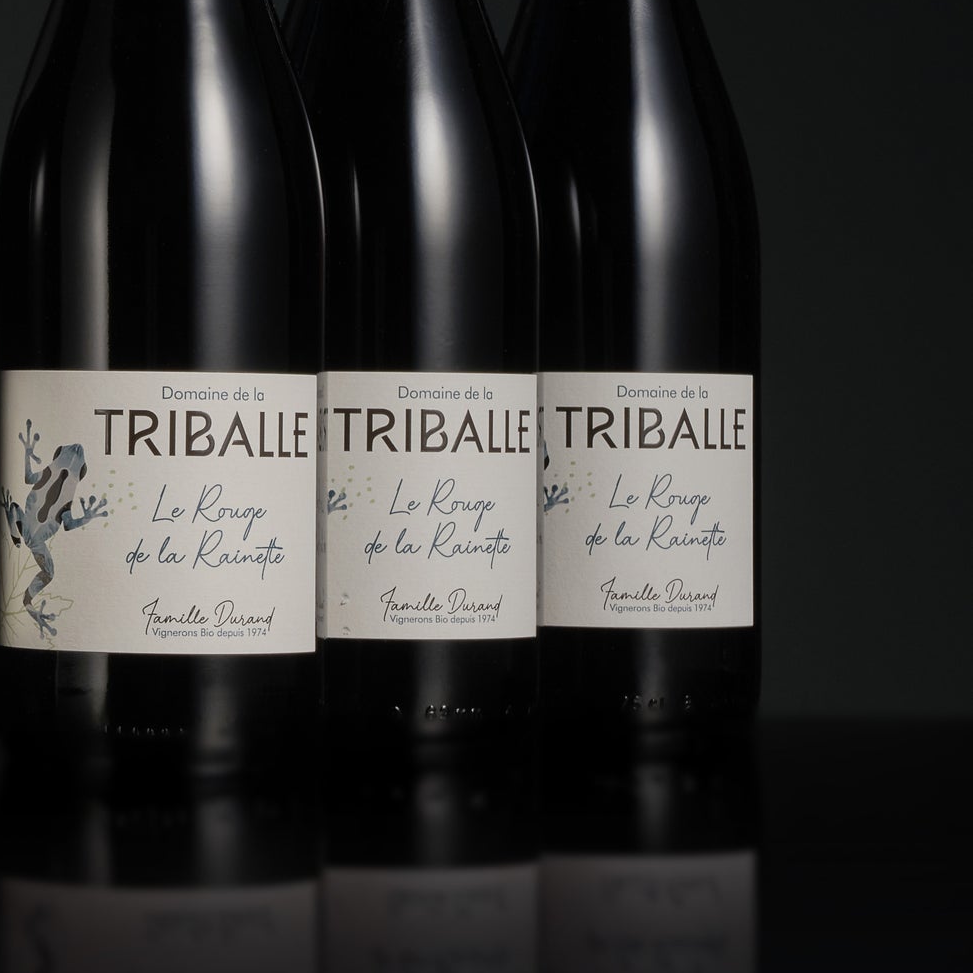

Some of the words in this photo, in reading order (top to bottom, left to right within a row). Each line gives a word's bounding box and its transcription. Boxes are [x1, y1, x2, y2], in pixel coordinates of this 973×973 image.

[162, 386, 229, 401] Domaine
[233, 387, 250, 401] de
[253, 387, 265, 401] la
[398, 386, 460, 400] Domaine
[465, 386, 481, 401] de
[483, 387, 493, 401] la
[617, 385, 677, 399] Domaine
[680, 385, 696, 399] de
[698, 385, 708, 399] la
[94, 409, 308, 458] TRIBALLE
[333, 408, 530, 453] TRIBALLE
[556, 406, 746, 450] TRIBALLE
[152, 484, 185, 523] Le
[192, 484, 267, 541] Rouge
[389, 478, 421, 516] Le
[427, 479, 496, 532] Rouge
[609, 473, 639, 509] Le
[645, 473, 711, 524] Rouge
[126, 538, 150, 574] de
[158, 536, 186, 563] la
[193, 529, 285, 580] Rainette
[364, 530, 387, 565] de
[394, 528, 422, 554] la
[428, 522, 511, 569] Rainette
[585, 522, 607, 557] de
[614, 522, 640, 546] la
[646, 515, 727, 560] Rainette
[380, 586, 444, 622] Famille
[448, 588, 502, 618] Durand
[600, 576, 661, 610] Famille
[665, 578, 719, 607] Durand
[609, 604, 651, 614] Vignerons
[653, 604, 666, 612] Bio
[667, 604, 692, 614] depuis
[694, 603, 712, 612] 1974
[142, 598, 209, 635] Famille
[213, 600, 275, 631] Durand
[152, 628, 198, 639] Vignerons
[201, 628, 214, 637] Bio
[217, 627, 244, 638] depuis
[247, 627, 267, 637] 1974
[389, 615, 433, 625] Vignerons
[435, 615, 448, 623] Bio
[450, 615, 476, 625] depuis
[478, 615, 496, 623] 1974
